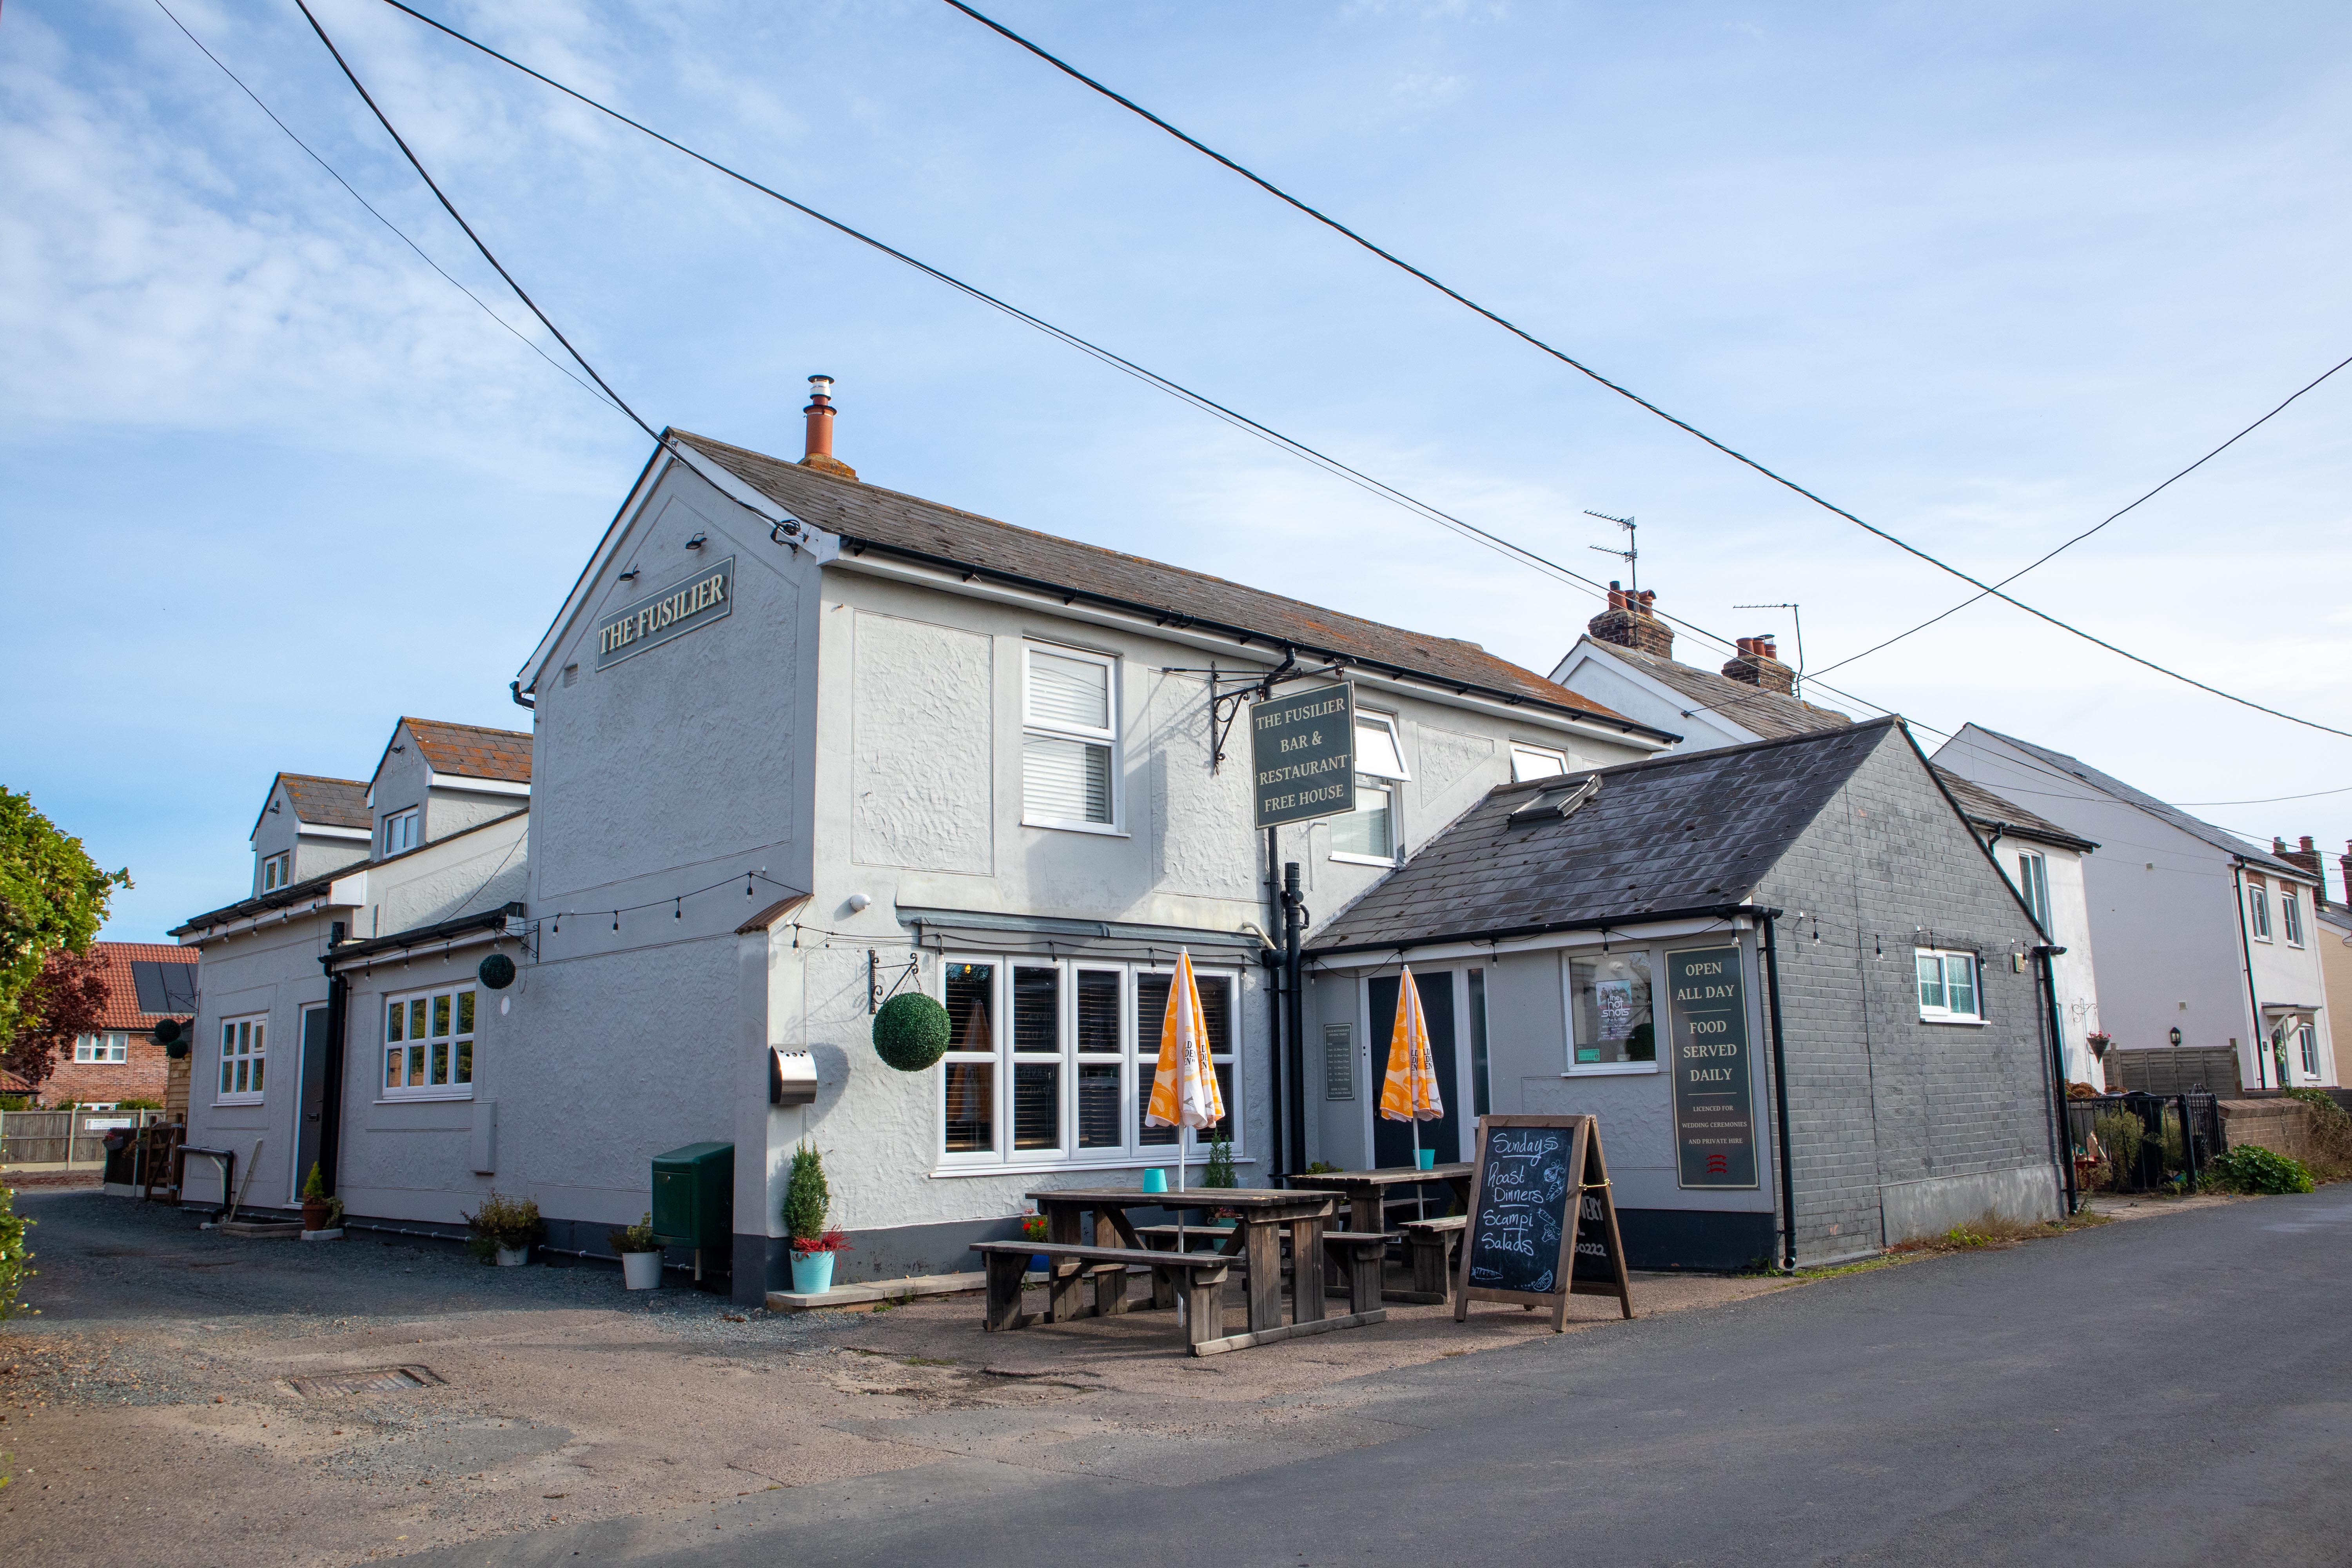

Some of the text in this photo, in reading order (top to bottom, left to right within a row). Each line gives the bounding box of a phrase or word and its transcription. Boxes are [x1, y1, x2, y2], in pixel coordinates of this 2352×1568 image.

[599, 574, 724, 654] THE FUSILIER
[1256, 698, 1345, 730] THE FUSILIER
[1280, 731, 1322, 753] BAR &
[1259, 754, 1347, 786] RESTAURANT
[1265, 784, 1344, 812] FREE HOUSE
[1686, 962, 1722, 976] OPEN
[1608, 997, 1624, 1009] hot
[1677, 985, 1735, 1000] ALL DAY
[1601, 1008, 1630, 1017] shots
[1690, 1021, 1727, 1034] FOOD
[1683, 1044, 1737, 1058] SERVED
[1690, 1068, 1733, 1082] DAILY
[1493, 1132, 1558, 1166] Sundays
[1488, 1162, 1524, 1187] Roast
[1493, 1187, 1544, 1203] Dinners
[1483, 1209, 1534, 1232] Scampi
[1481, 1232, 1534, 1256] Salads
